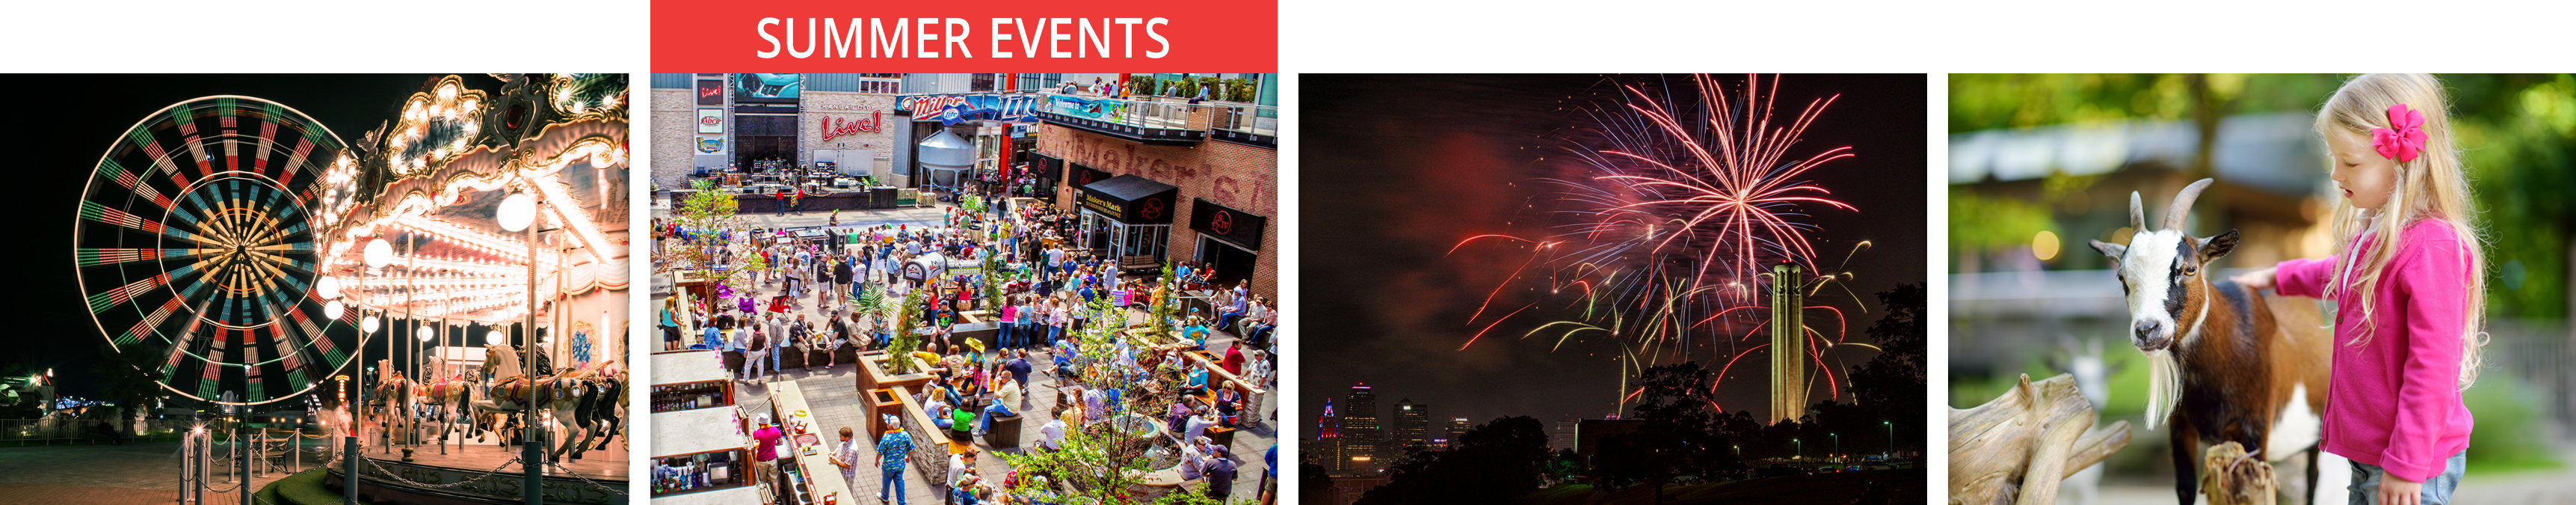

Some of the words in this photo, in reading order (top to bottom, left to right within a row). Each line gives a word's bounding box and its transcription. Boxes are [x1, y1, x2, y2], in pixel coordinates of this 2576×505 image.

[701, 85, 721, 98] Live!
[902, 95, 964, 118] Miller
[822, 109, 881, 141] Live!
[1074, 134, 1242, 206] Maker's
[1086, 194, 1106, 207] Maker's
[1106, 201, 1121, 213] Mark
